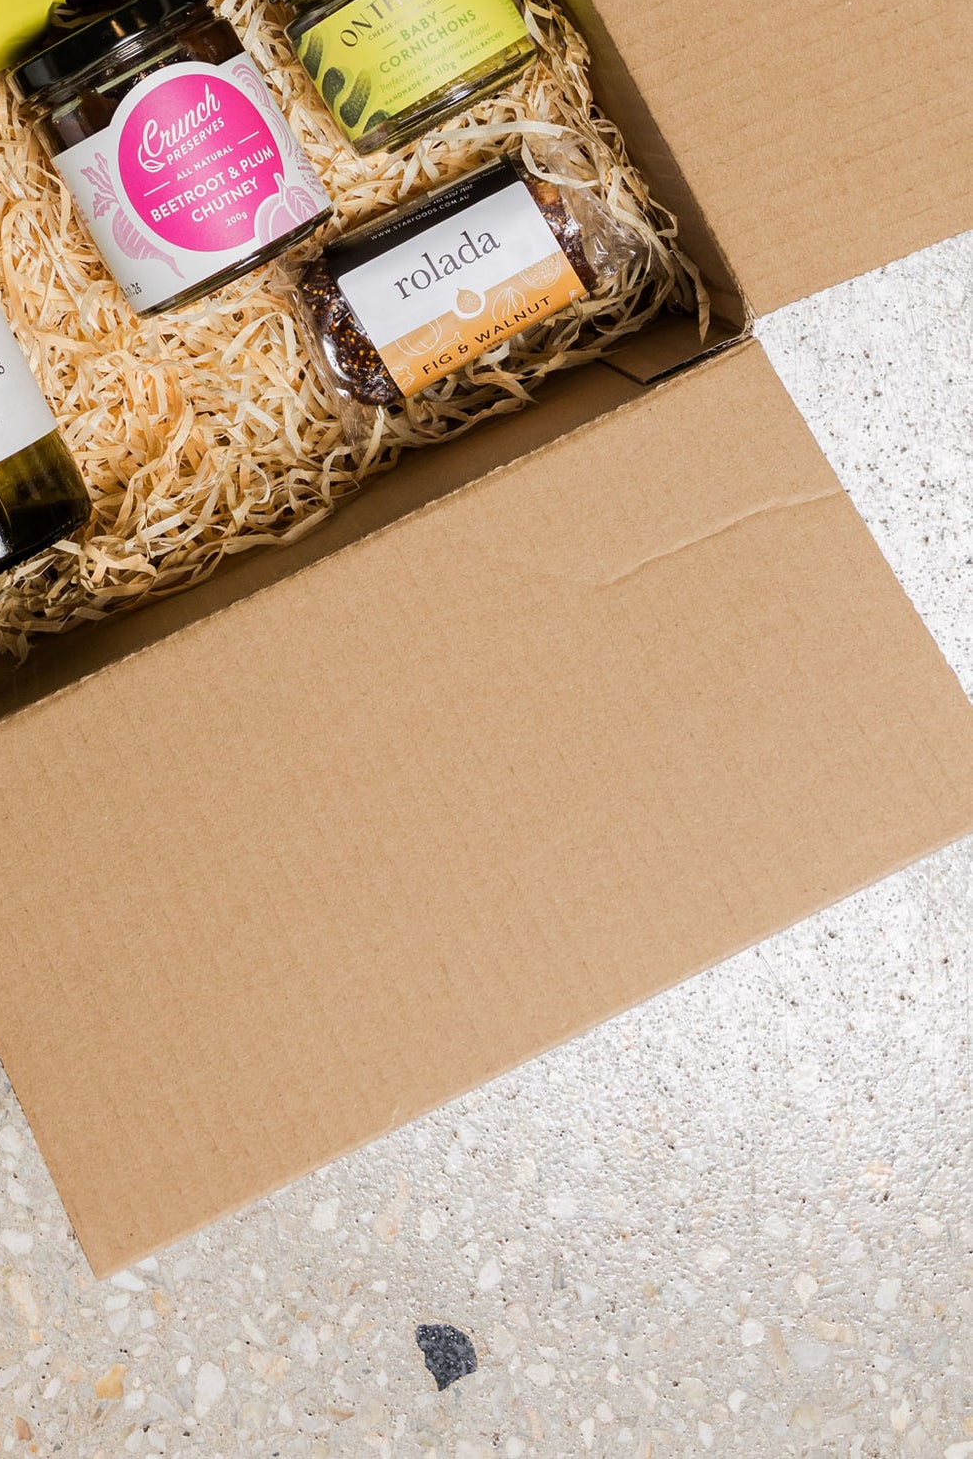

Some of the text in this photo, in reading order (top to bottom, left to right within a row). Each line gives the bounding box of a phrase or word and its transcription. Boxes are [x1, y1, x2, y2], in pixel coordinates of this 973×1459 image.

[339, 13, 373, 48] ON
[368, 21, 394, 41] CHEESE
[379, 9, 477, 74] CORNICHONS
[400, 11, 438, 42] BABY
[378, 70, 407, 92] Perfect
[384, 80, 422, 105] HANDMADE
[436, 60, 457, 77] 110g
[142, 83, 221, 159] Crunch
[166, 117, 225, 166] PRESERVES
[150, 172, 227, 223] BEETROOT
[228, 166, 241, 179] &
[239, 146, 275, 172] PLUM
[177, 145, 234, 182] ALL NATURAL
[191, 177, 259, 223] CHUTNEY
[225, 211, 248, 227] 200g
[394, 231, 501, 300] rolada
[422, 353, 453, 375] FIG
[457, 344, 469, 354] &
[474, 296, 550, 344] WALNUT
